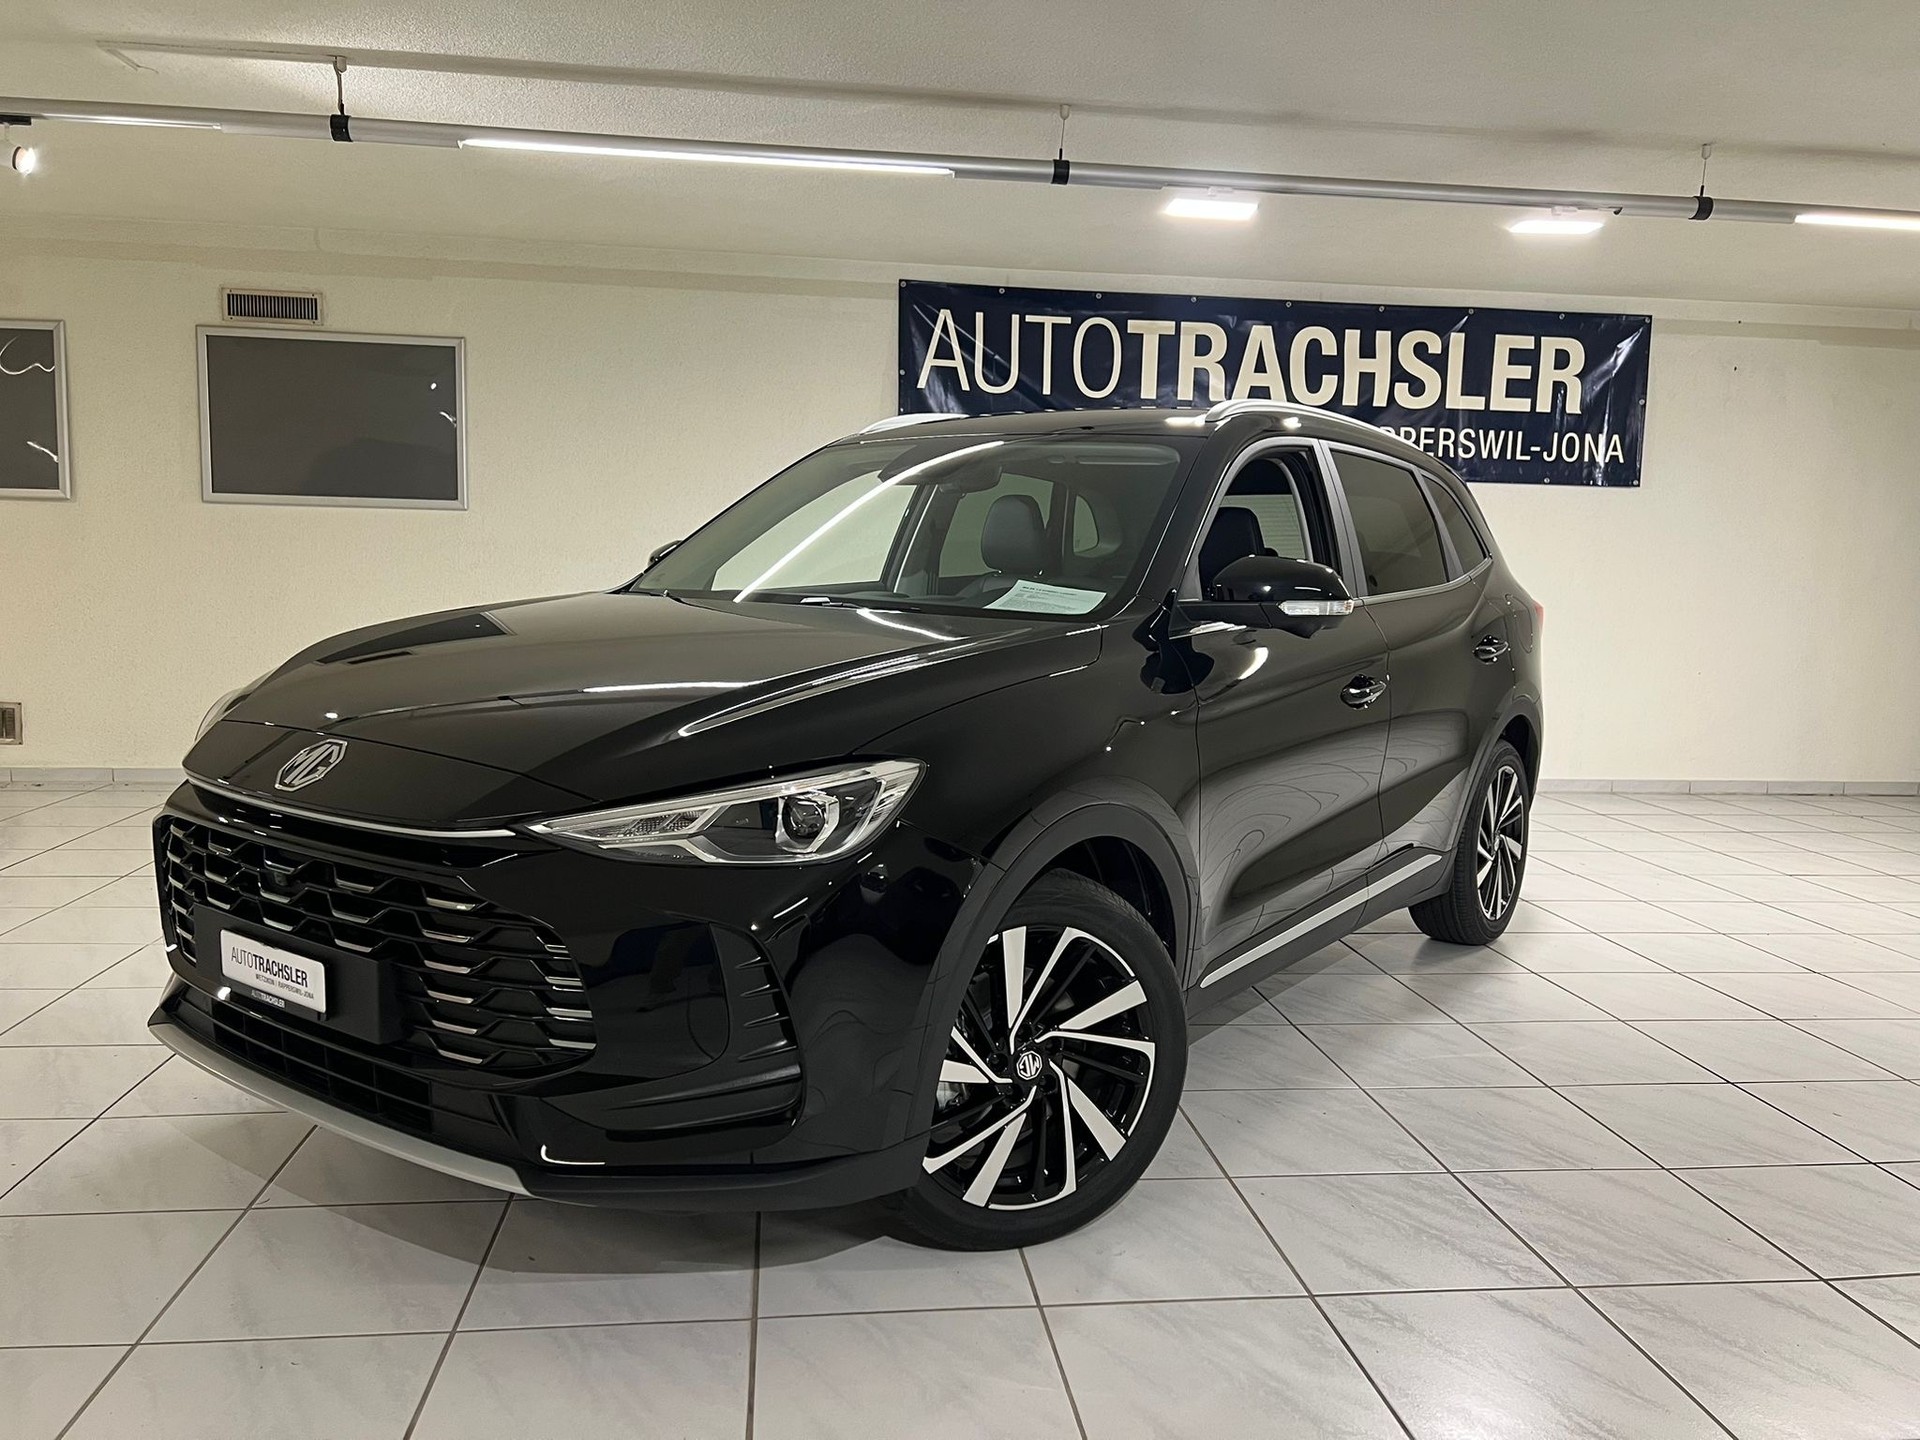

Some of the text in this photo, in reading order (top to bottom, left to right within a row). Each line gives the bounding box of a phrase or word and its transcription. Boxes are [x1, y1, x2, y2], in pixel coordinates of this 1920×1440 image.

[915, 307, 1587, 414] AUTOTRACHSLER
[282, 742, 342, 787] MG
[231, 946, 308, 988] AUTOTRACHSLER
